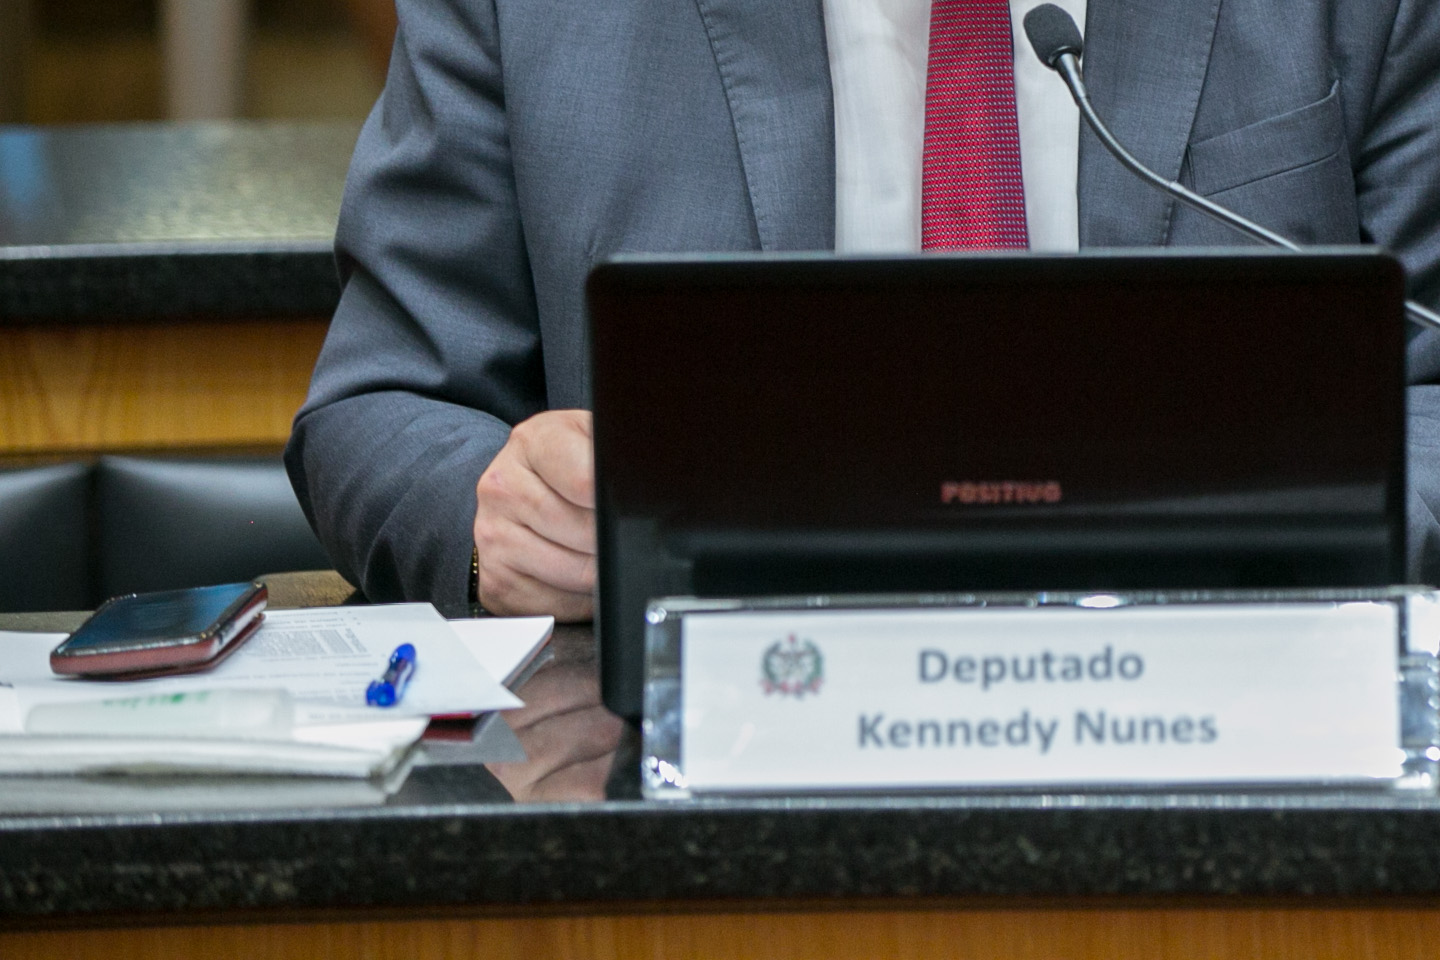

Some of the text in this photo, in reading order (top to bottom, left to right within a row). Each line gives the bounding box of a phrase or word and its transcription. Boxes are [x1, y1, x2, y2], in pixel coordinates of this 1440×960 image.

[941, 481, 1062, 503] POSITIVO
[919, 645, 1145, 690] Deputado
[858, 709, 1219, 753] Kennedy Nunes
